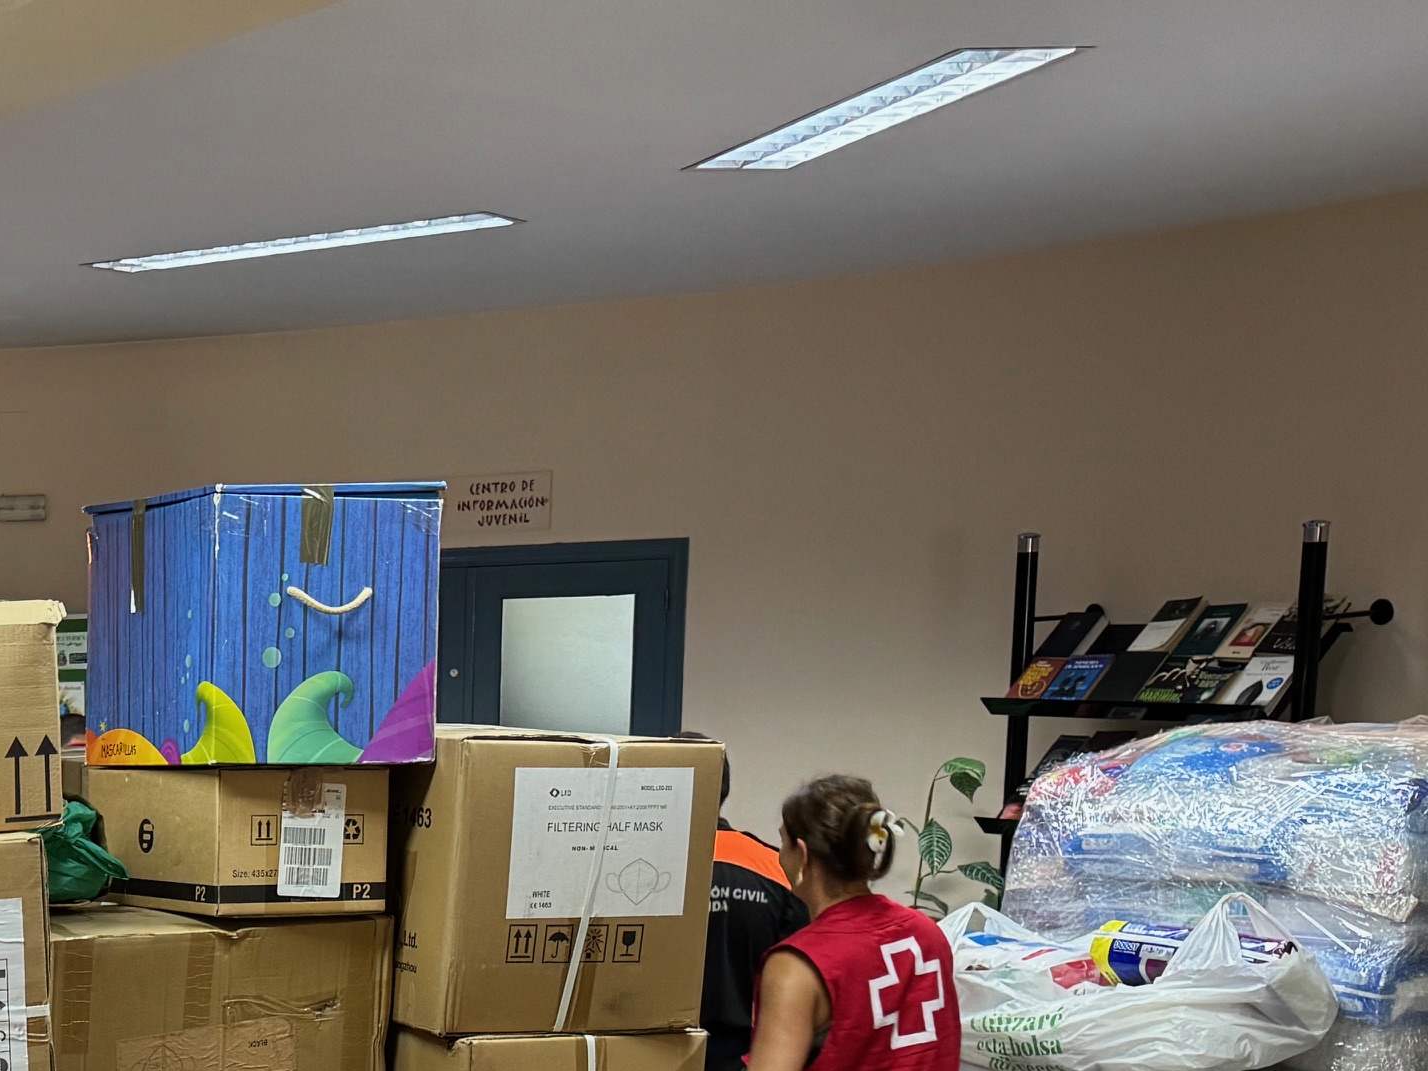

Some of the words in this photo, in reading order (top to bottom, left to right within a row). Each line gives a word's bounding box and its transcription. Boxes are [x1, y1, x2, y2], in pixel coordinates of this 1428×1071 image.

[469, 481, 516, 495] CENTRO
[521, 479, 535, 492] DE
[477, 513, 530, 527] JUVENIL
[633, 821, 664, 832] MASK
[232, 869, 250, 879] Size:
[194, 885, 206, 902] P2
[352, 883, 371, 899] P2
[532, 890, 551, 898] WHITE
[732, 888, 768, 904] CIVIL
